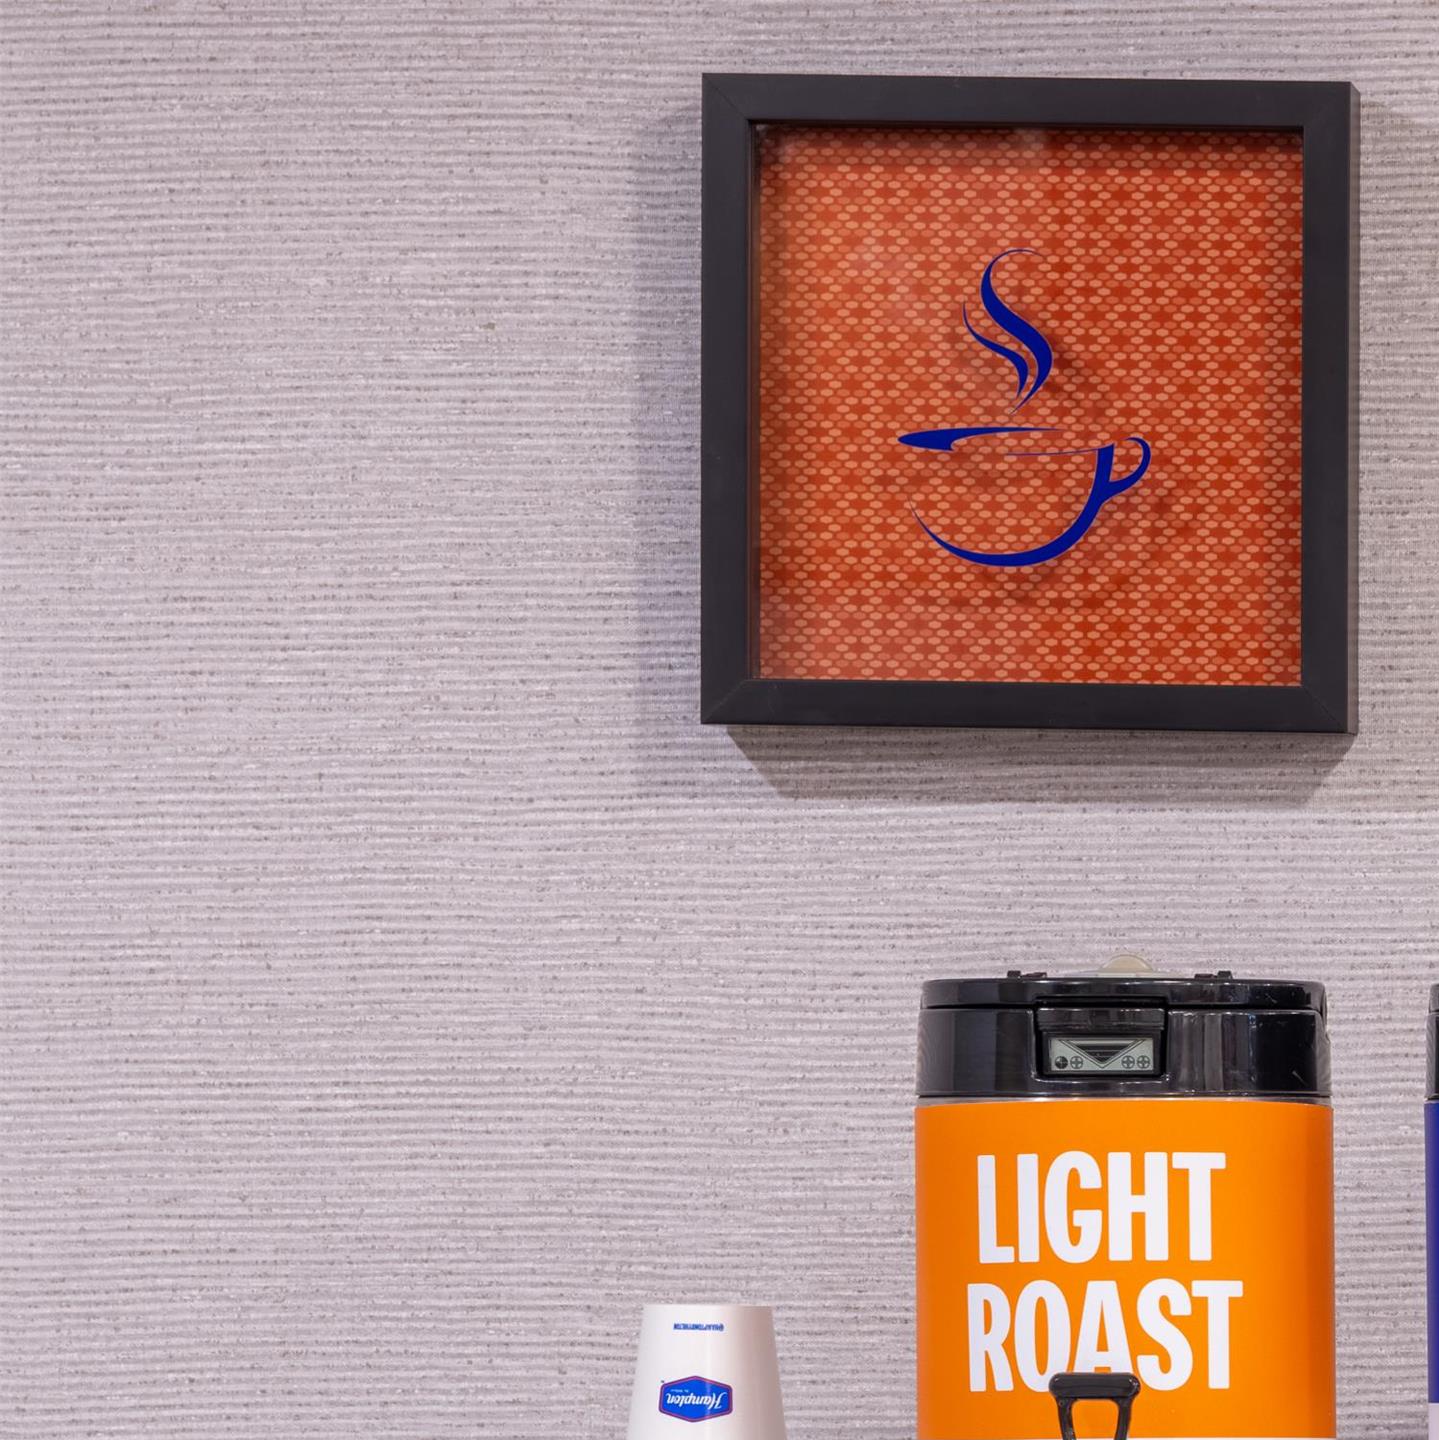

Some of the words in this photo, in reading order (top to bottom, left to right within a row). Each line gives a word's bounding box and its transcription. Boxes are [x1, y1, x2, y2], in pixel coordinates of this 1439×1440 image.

[976, 1150, 1226, 1264] LIGHT
[966, 1278, 1244, 1392] ROAST
[665, 1392, 727, 1410] Hampton
